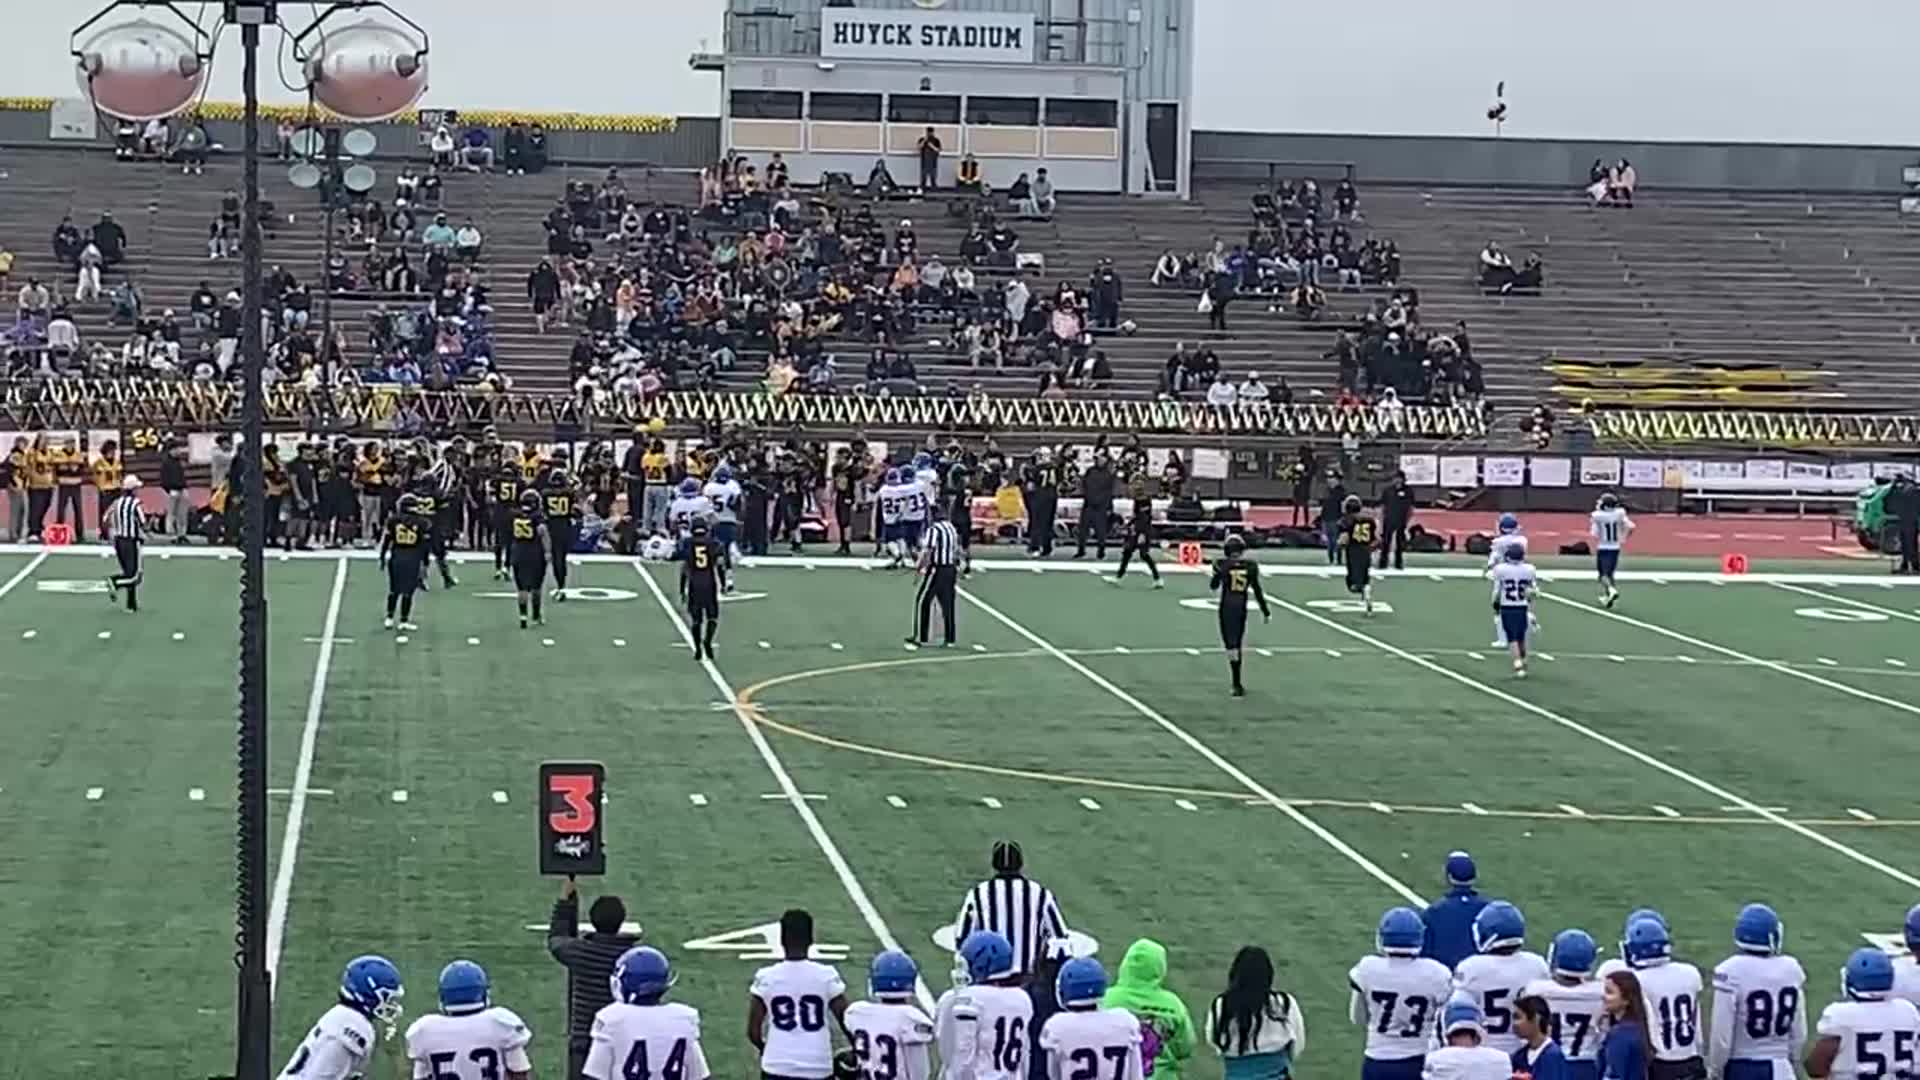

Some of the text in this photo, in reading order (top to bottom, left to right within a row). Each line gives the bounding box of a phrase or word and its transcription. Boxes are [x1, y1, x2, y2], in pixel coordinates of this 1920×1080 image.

[833, 22, 1022, 49] HUYCK STADIUM
[501, 483, 517, 500] 51
[547, 497, 569, 515] 50
[1352, 523, 1371, 542] 45
[1604, 521, 1618, 541] 11
[694, 546, 708, 569] 5
[1183, 545, 1200, 564] 50
[1727, 556, 1745, 574] 40
[1229, 569, 1248, 592] 15
[548, 775, 596, 833] 3
[1371, 990, 1429, 1038] 73
[1746, 986, 1798, 1038] 88
[992, 1015, 1025, 1072] 16
[1855, 1030, 1920, 1080] 55
[430, 1047, 499, 1080] 53
[622, 1038, 688, 1080] 44
[1070, 1046, 1129, 1080] 27
